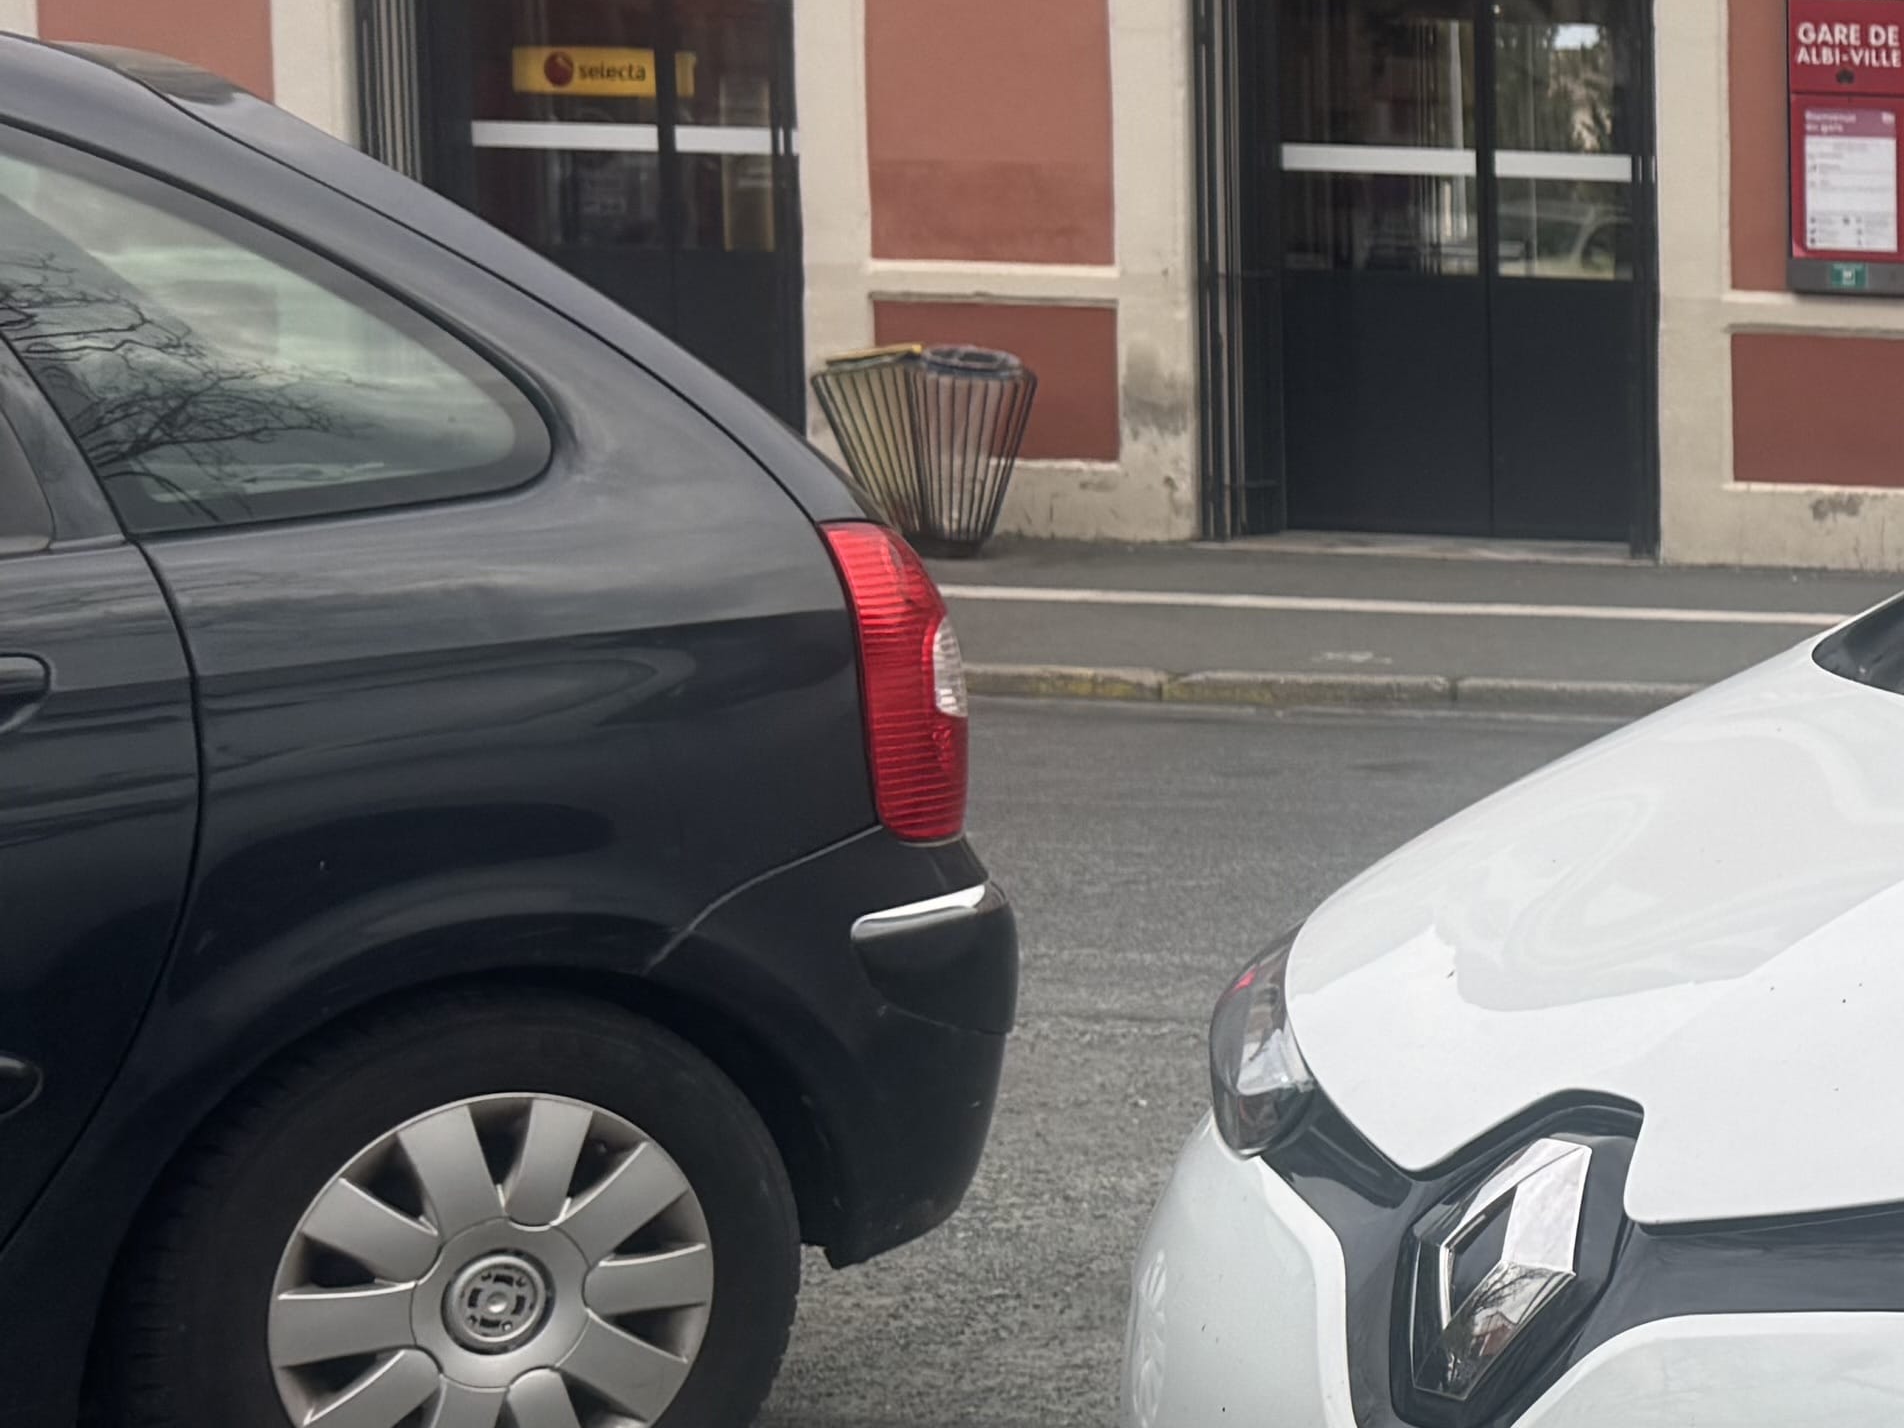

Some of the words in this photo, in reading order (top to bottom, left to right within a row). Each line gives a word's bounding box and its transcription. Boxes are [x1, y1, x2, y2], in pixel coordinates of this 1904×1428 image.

[1797, 21, 1861, 46] GARE
[1869, 23, 1900, 47] DE
[1796, 45, 1902, 68] ALBI-VILLE
[578, 59, 646, 82] selecta
